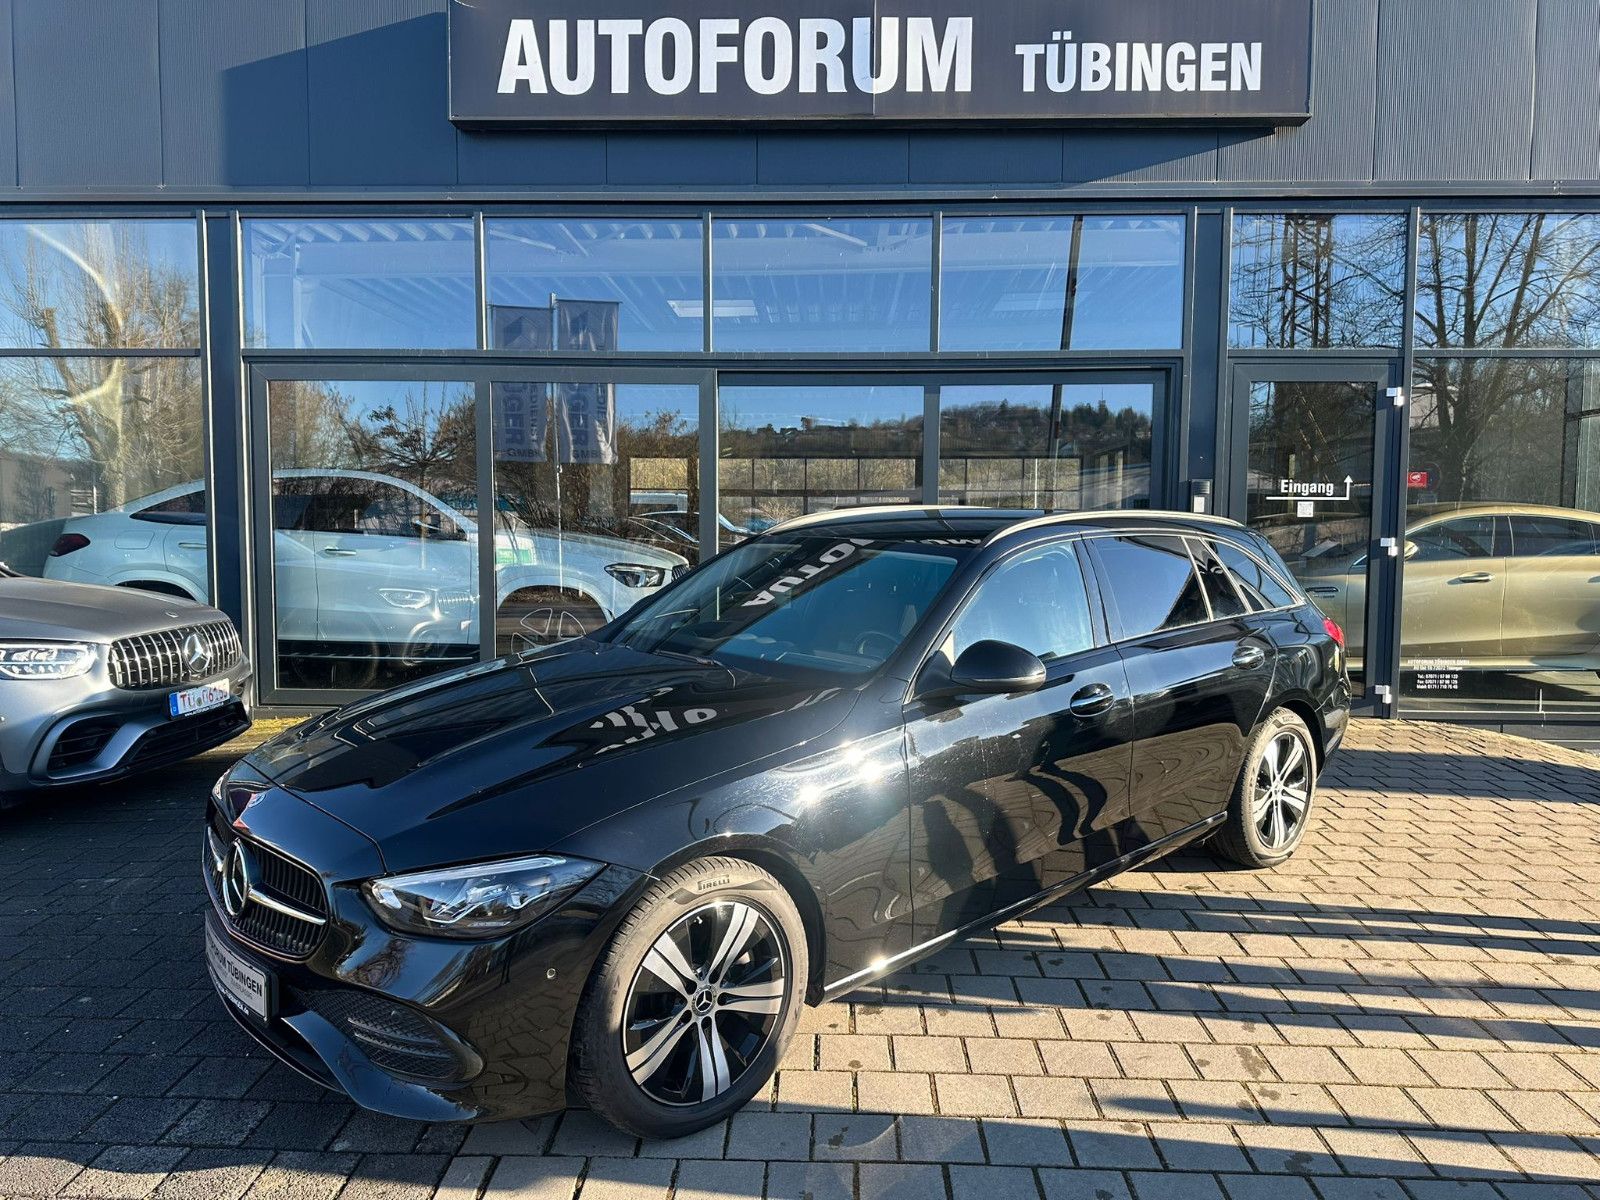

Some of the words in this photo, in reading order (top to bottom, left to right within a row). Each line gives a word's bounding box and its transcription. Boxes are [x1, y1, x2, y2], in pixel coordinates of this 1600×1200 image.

[497, 17, 973, 96] AUTOFORUM
[1015, 31, 1262, 92] TÜBINGEN
[1280, 480, 1335, 496] Eingang
[698, 874, 730, 891] PIRELLI
[227, 960, 263, 997] TÜBINGEN
